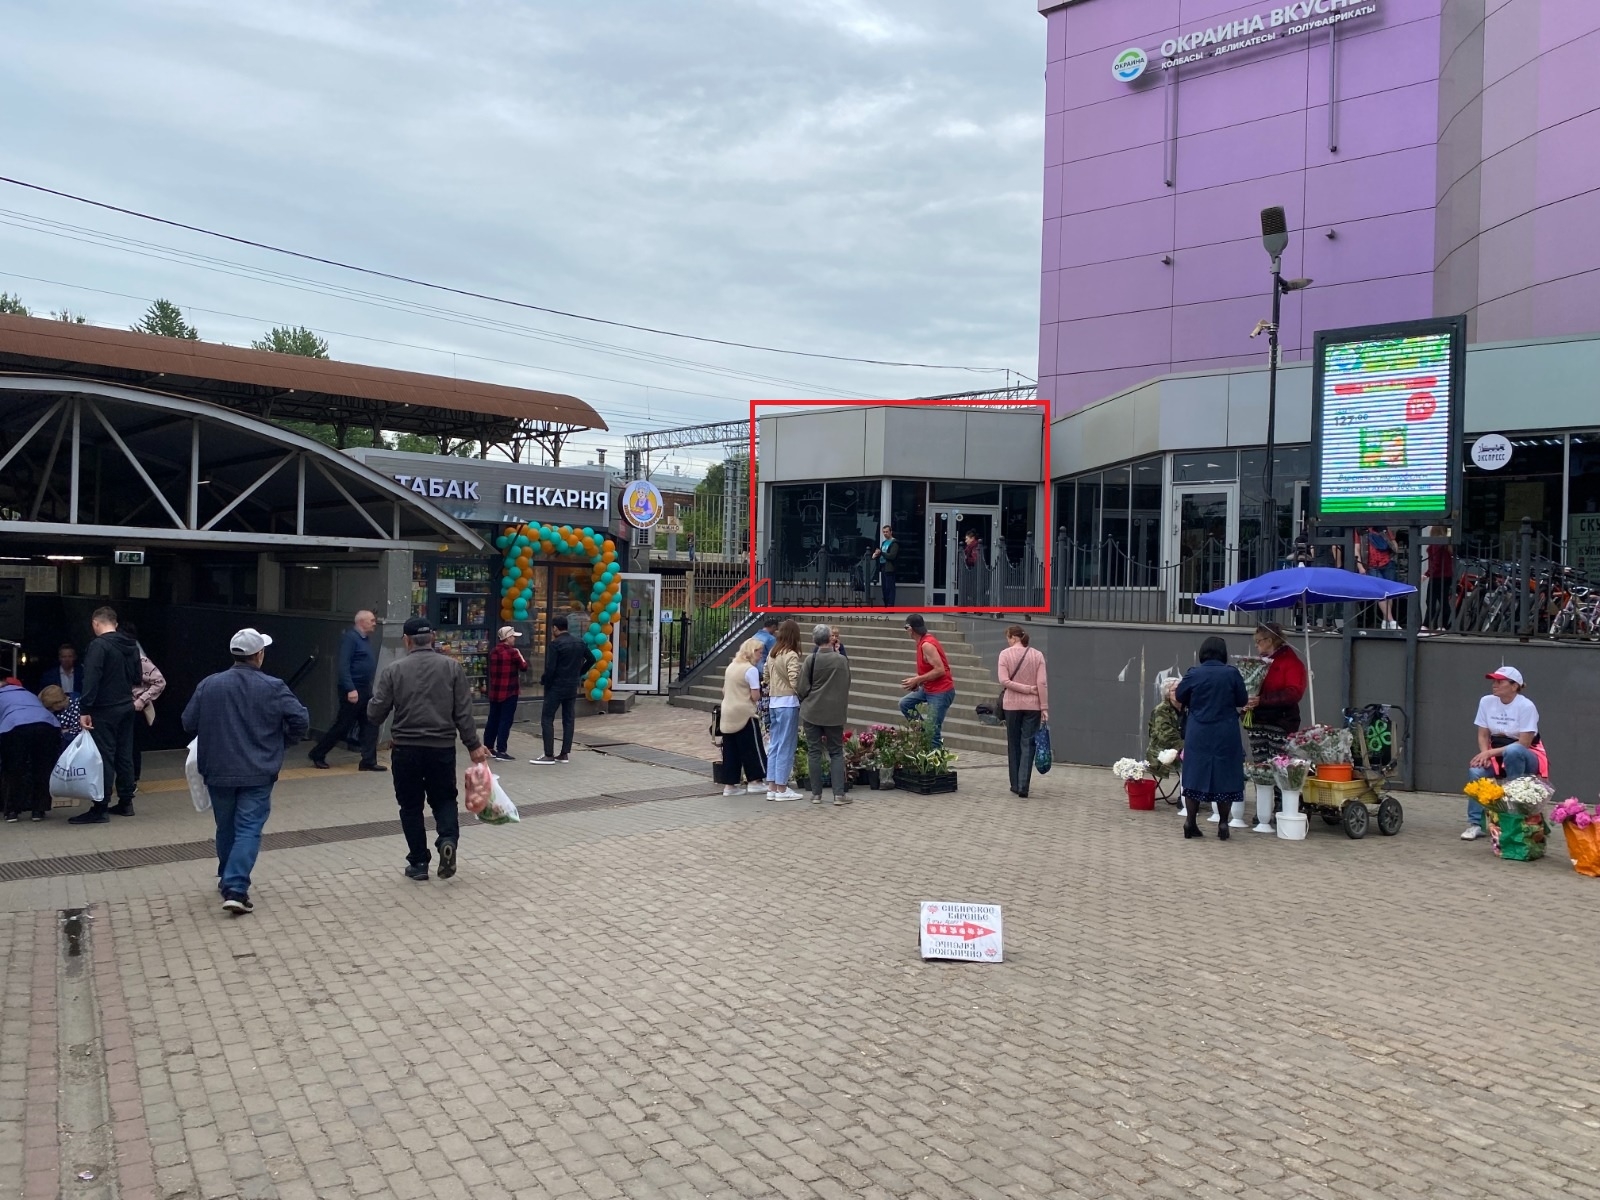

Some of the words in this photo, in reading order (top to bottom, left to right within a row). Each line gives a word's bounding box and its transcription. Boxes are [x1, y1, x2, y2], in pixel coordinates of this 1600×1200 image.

[1160, 15, 1264, 57] ОКРАИНА
[1161, 52, 1204, 70] КОЛБАСЫ
[1215, 33, 1276, 57] ДЕЛИКАТЕСЫ
[1288, 4, 1376, 36] ПОЛУФАБРИКАТЫ
[1114, 57, 1145, 71] ОКРАИНА
[1477, 453, 1505, 462] ЭКСПРЕСС
[394, 474, 479, 500] ТАБАК
[505, 484, 608, 510] ПЕКАРНЯ
[941, 904, 995, 914] СИБИРСКОЕ
